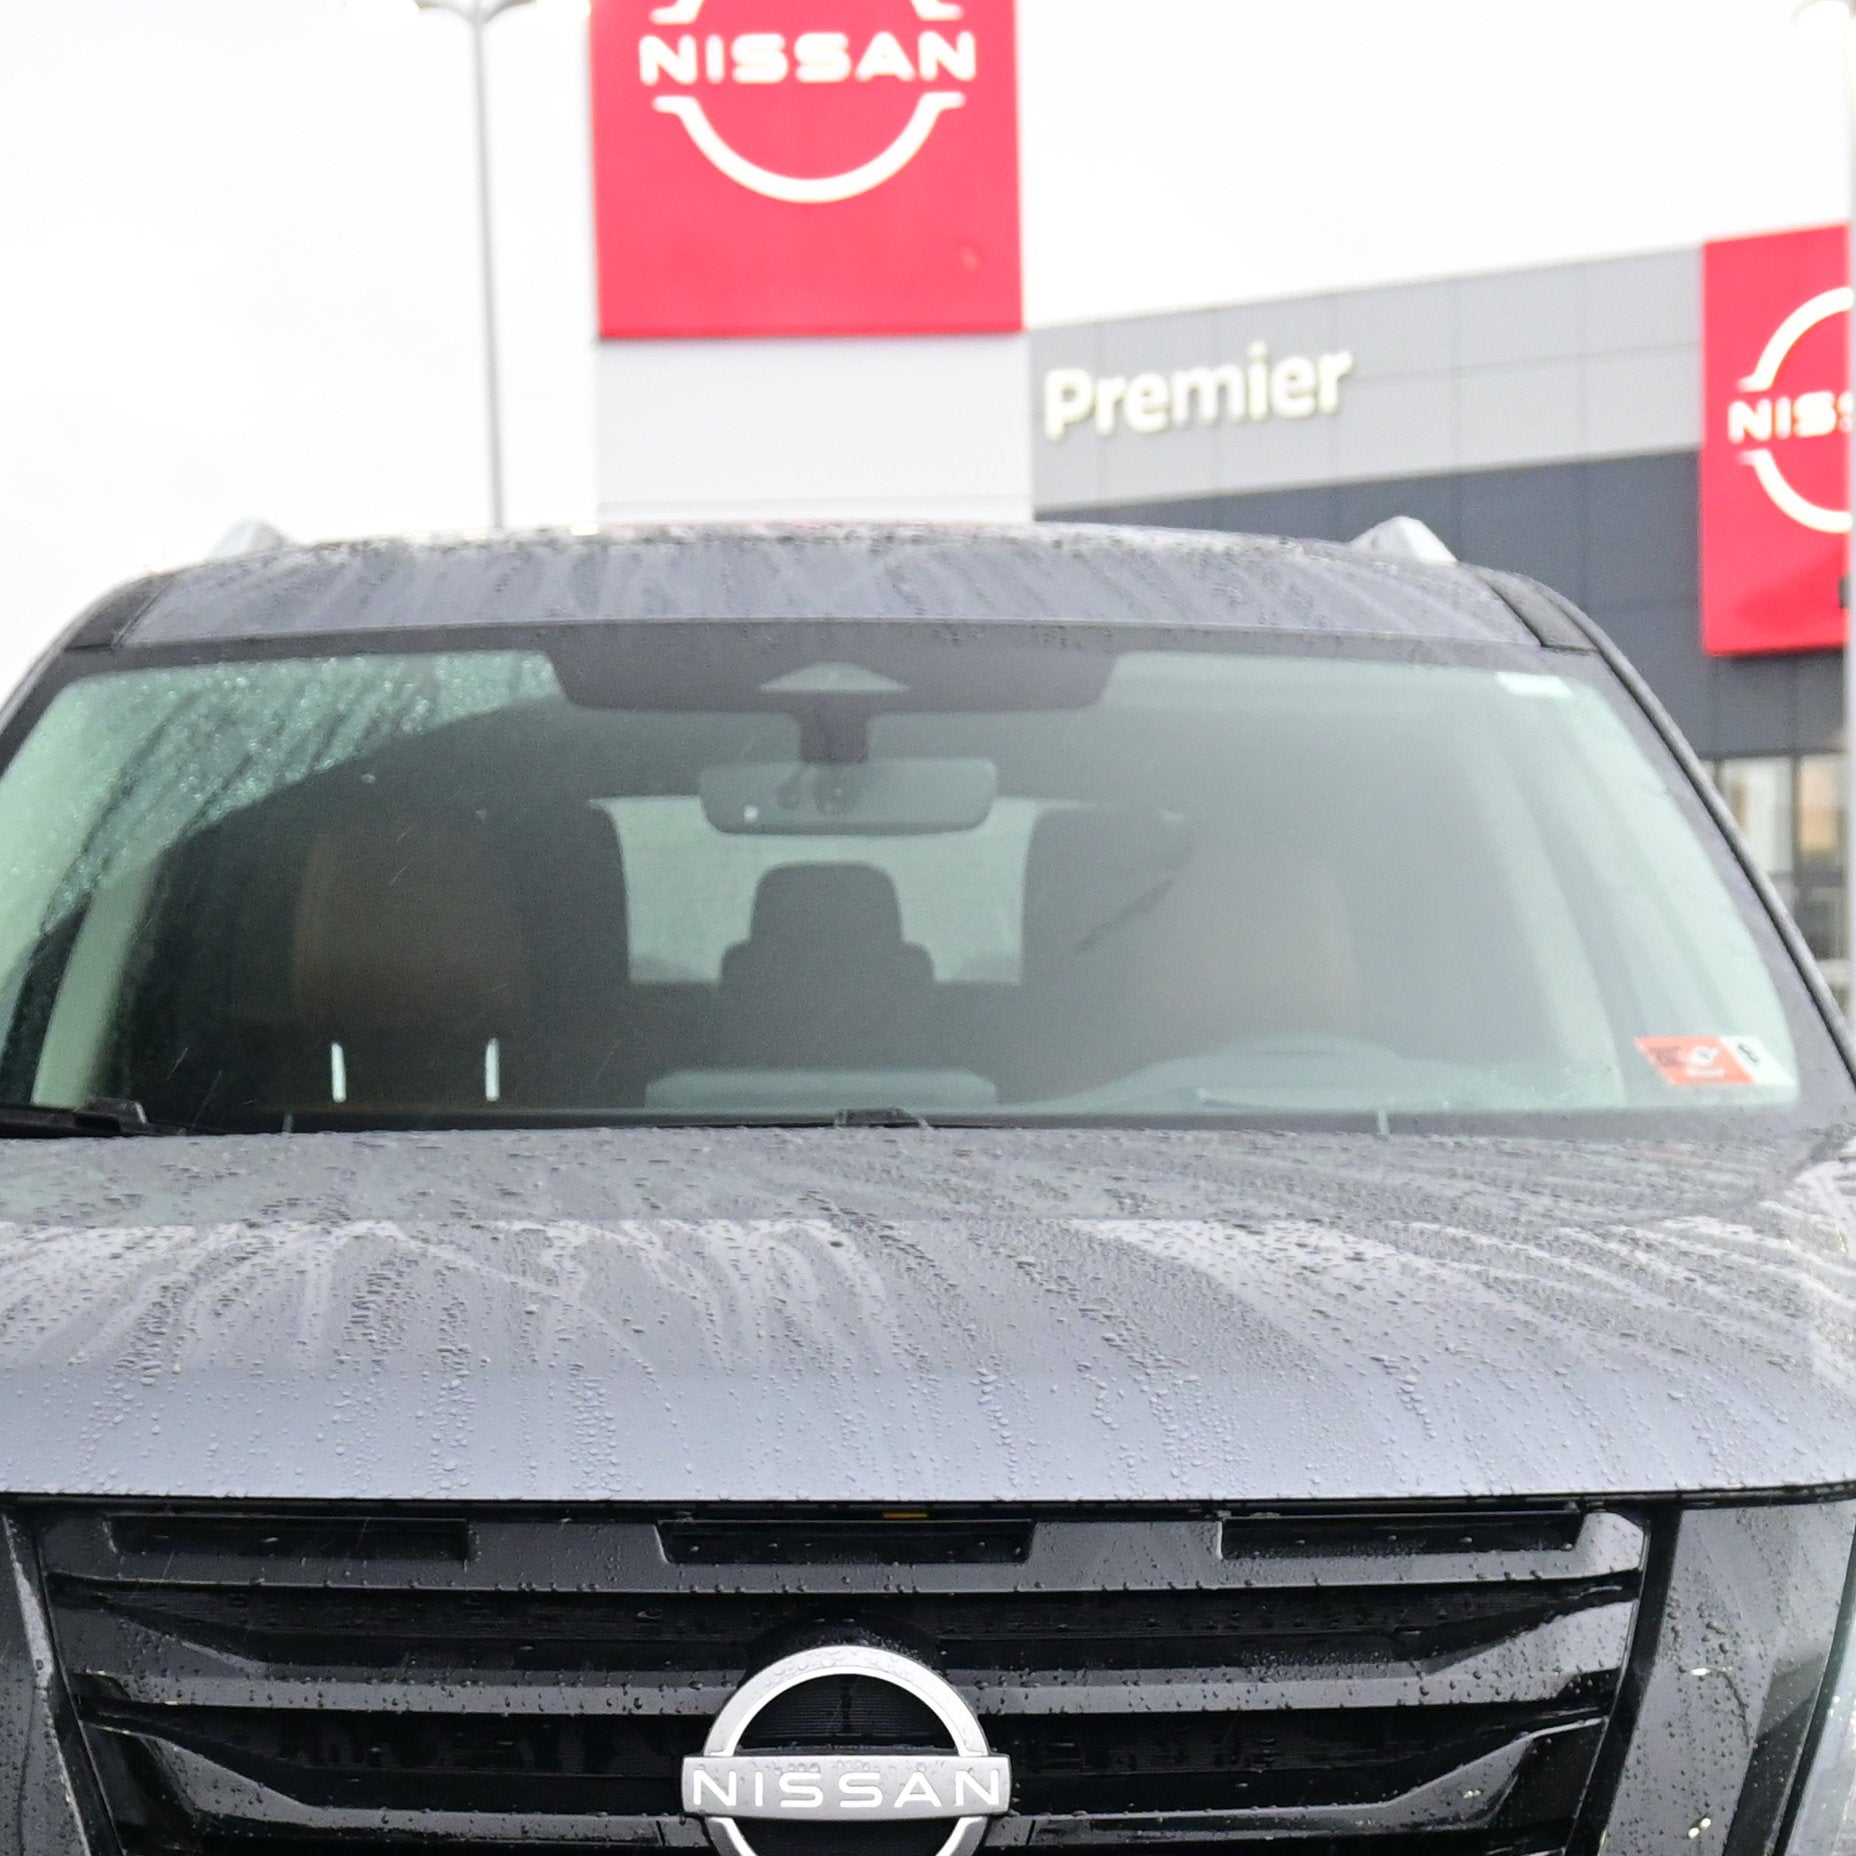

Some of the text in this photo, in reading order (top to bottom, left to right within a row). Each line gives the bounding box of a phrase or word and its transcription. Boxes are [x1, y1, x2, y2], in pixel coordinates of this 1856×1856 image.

[639, 31, 976, 84] NISSAN
[1044, 341, 1352, 439] Premier
[692, 1769, 1000, 1808] NISSAN
